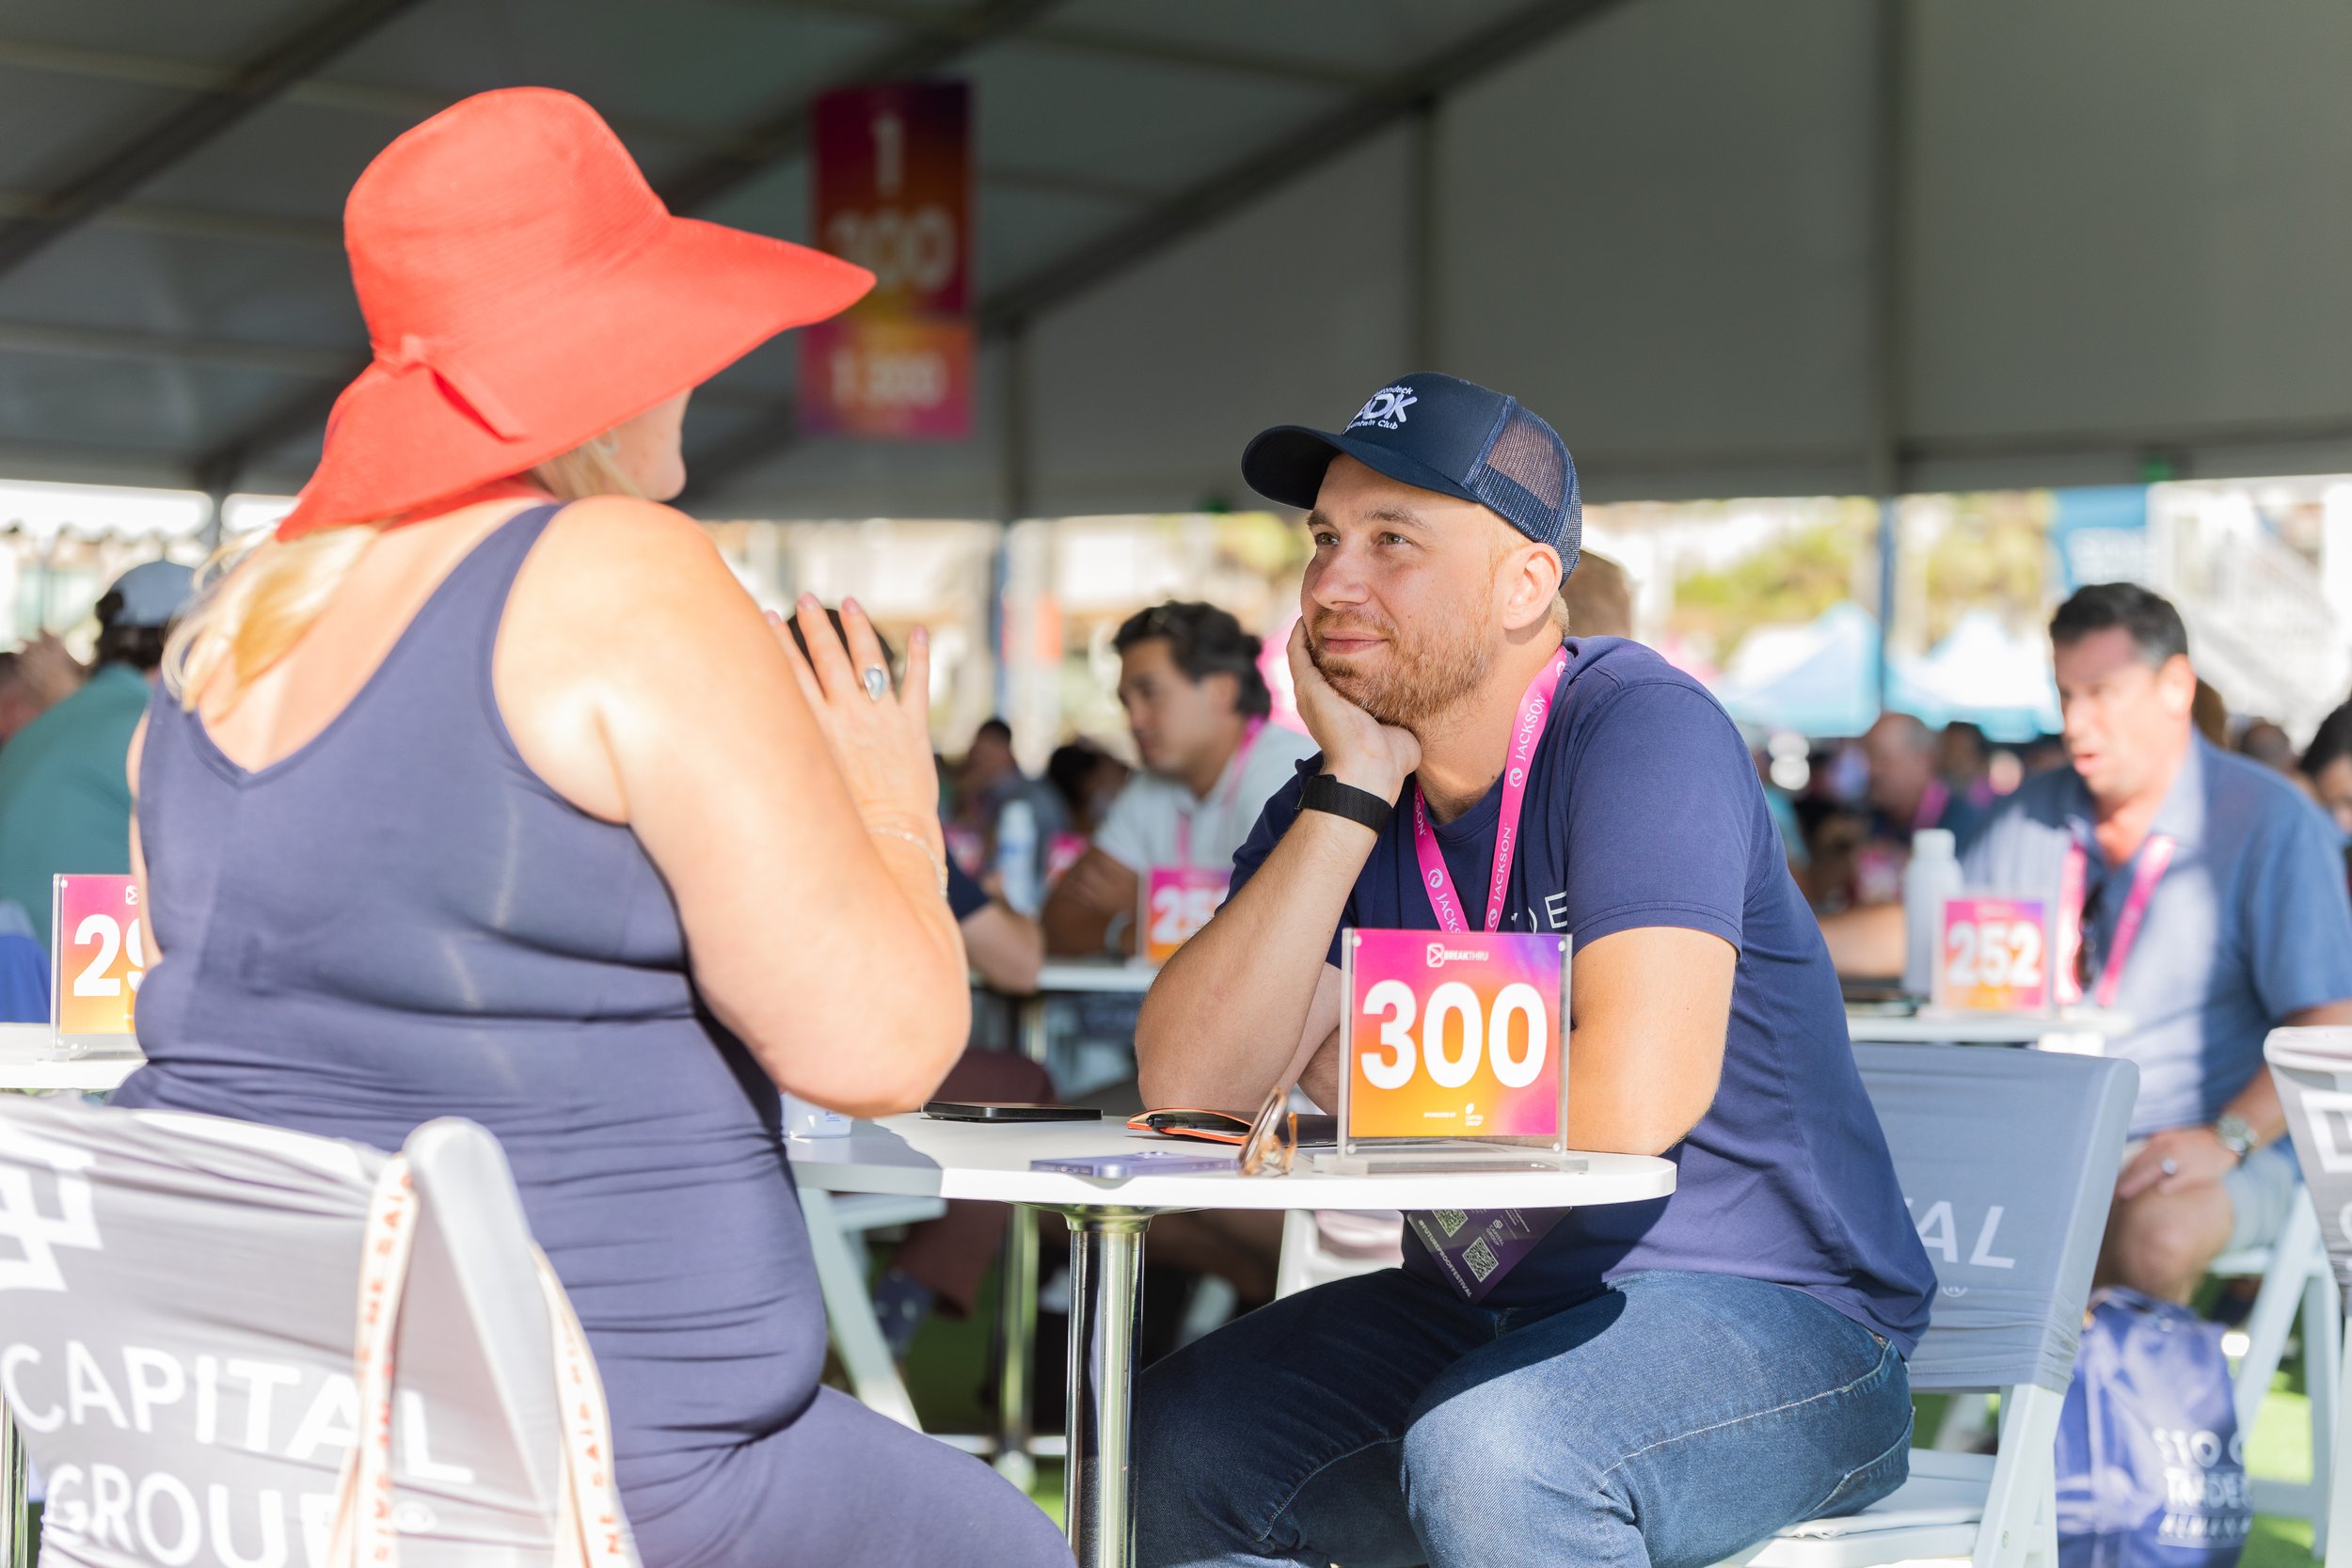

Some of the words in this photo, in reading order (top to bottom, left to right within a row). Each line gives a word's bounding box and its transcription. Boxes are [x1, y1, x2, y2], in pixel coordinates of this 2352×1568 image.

[1377, 420, 1399, 430] Club
[1516, 693, 1548, 761] JACKSON
[1493, 826, 1512, 902] JACKSON
[1152, 887, 1230, 943] 25
[1947, 922, 2041, 987] 252
[1360, 979, 1548, 1089] 300
